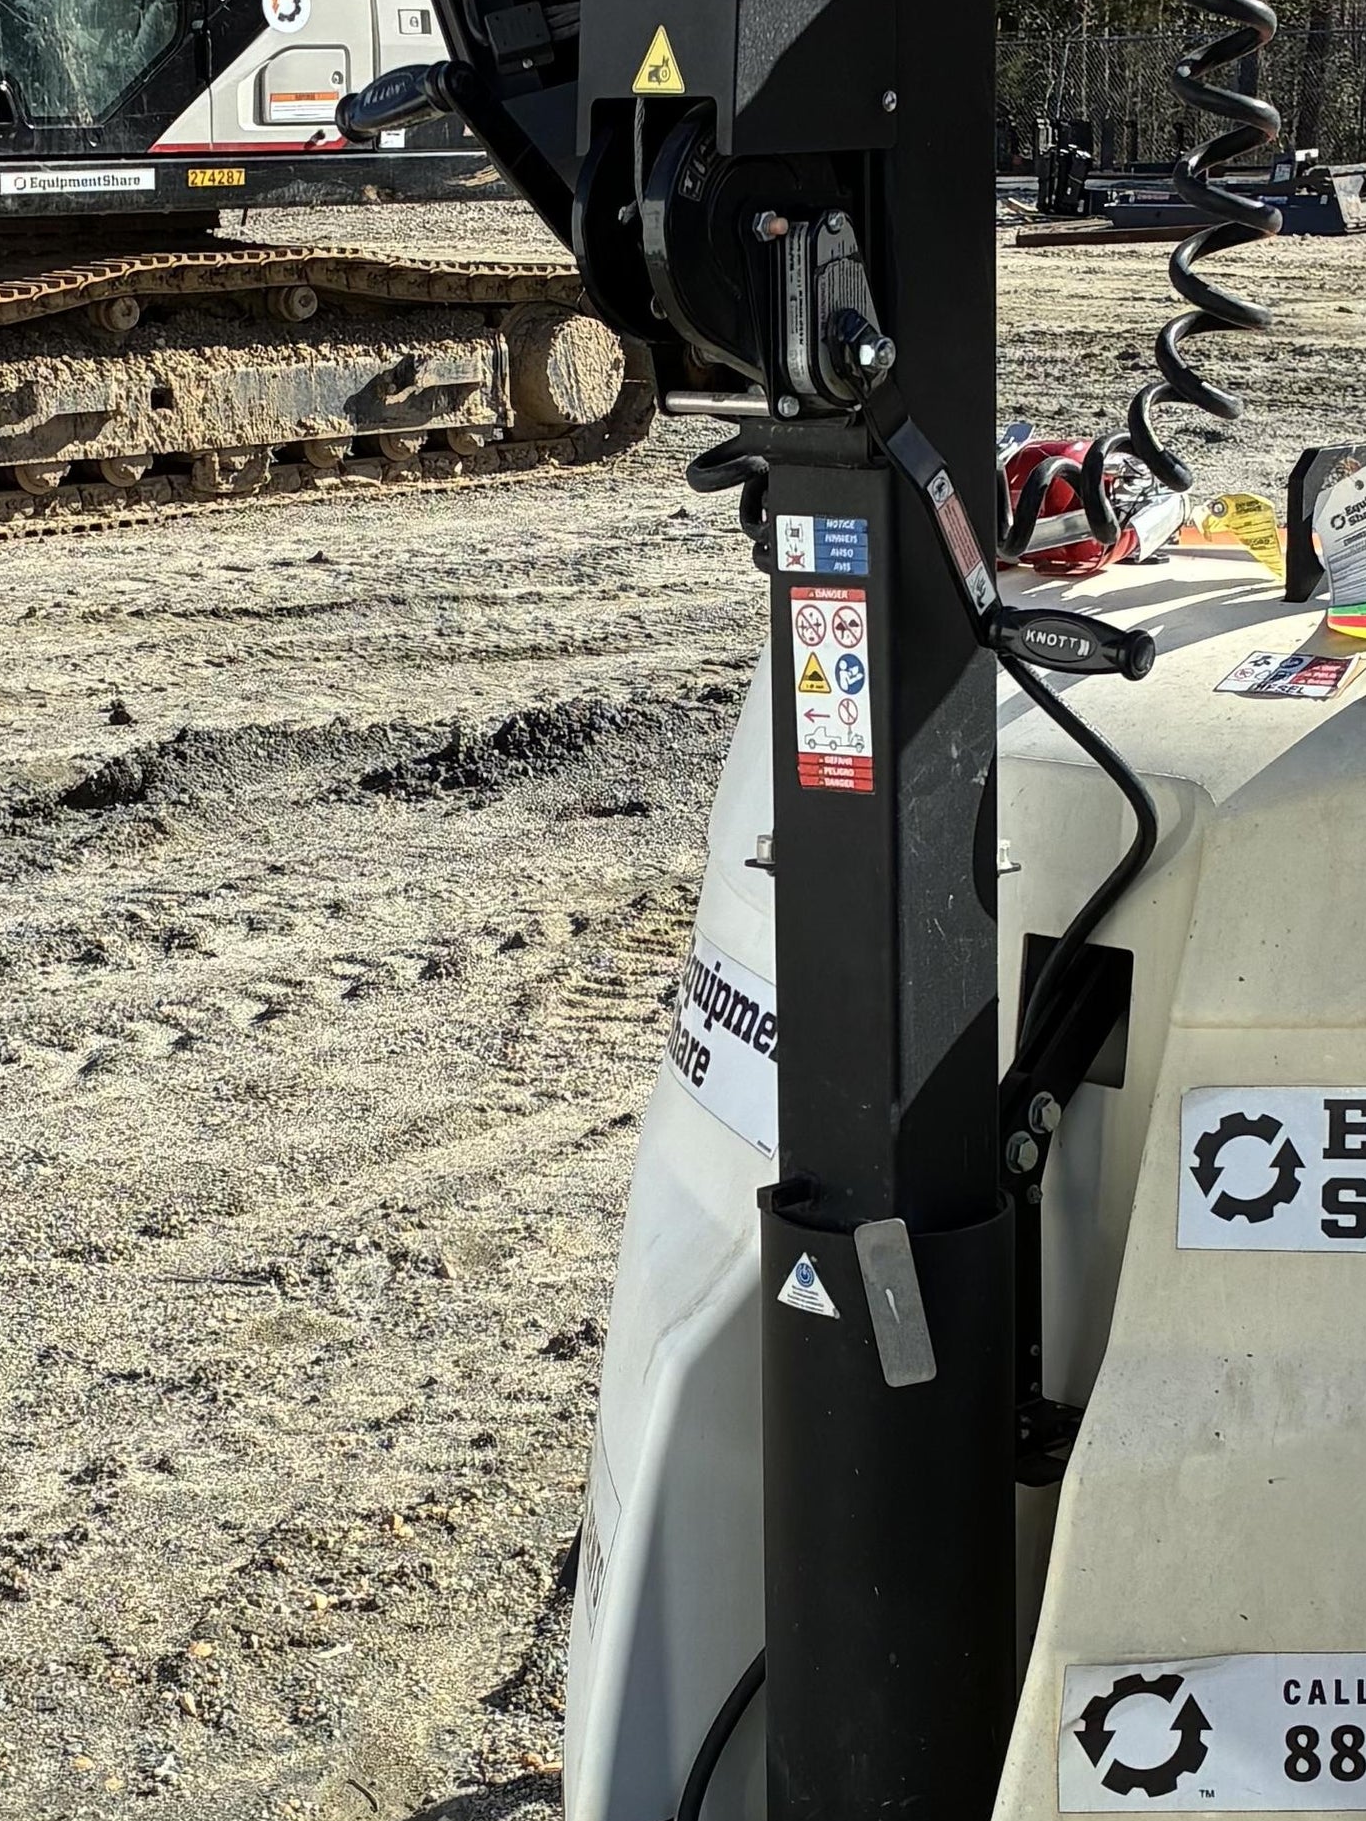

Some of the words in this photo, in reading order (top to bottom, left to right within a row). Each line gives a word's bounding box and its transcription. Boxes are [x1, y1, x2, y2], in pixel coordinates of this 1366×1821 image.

[30, 175, 141, 190] EquipmentShare
[189, 169, 244, 186] 274287
[1025, 629, 1078, 648] KNOTT
